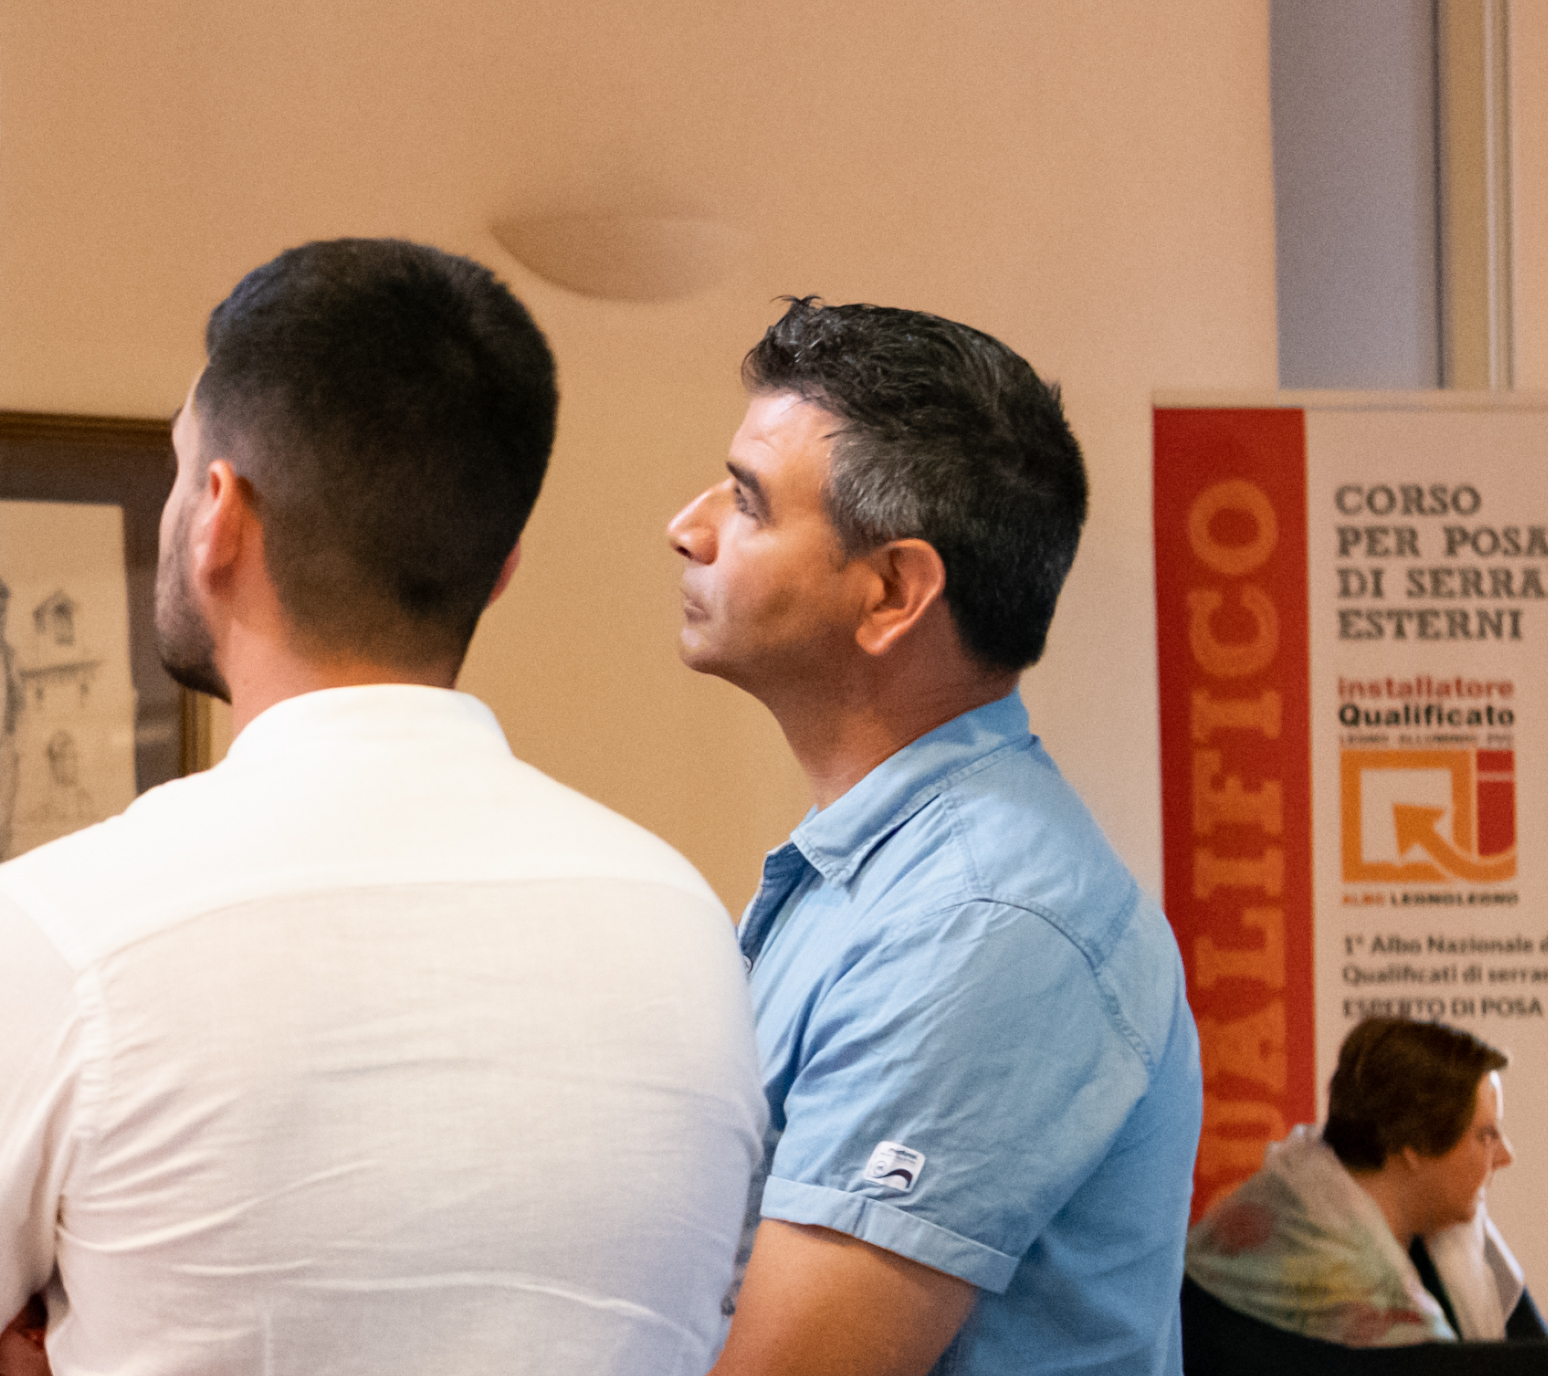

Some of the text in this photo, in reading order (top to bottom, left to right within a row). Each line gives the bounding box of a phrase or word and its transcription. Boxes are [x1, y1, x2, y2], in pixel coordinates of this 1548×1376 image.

[1335, 484, 1482, 516] CORSO
[1336, 525, 1421, 558] PER
[1337, 567, 1384, 600] DI
[1337, 608, 1523, 641] ESTERNI
[1338, 703, 1515, 727] Qualificato
[1188, 478, 1286, 1216] UALIFICO
[1370, 935, 1421, 955] Albo
[1427, 935, 1534, 955] Nazionale
[1342, 964, 1456, 987] Qualificati
[1463, 964, 1482, 983] di
[1453, 997, 1476, 1017] DI
[1482, 997, 1544, 1017] POSA
